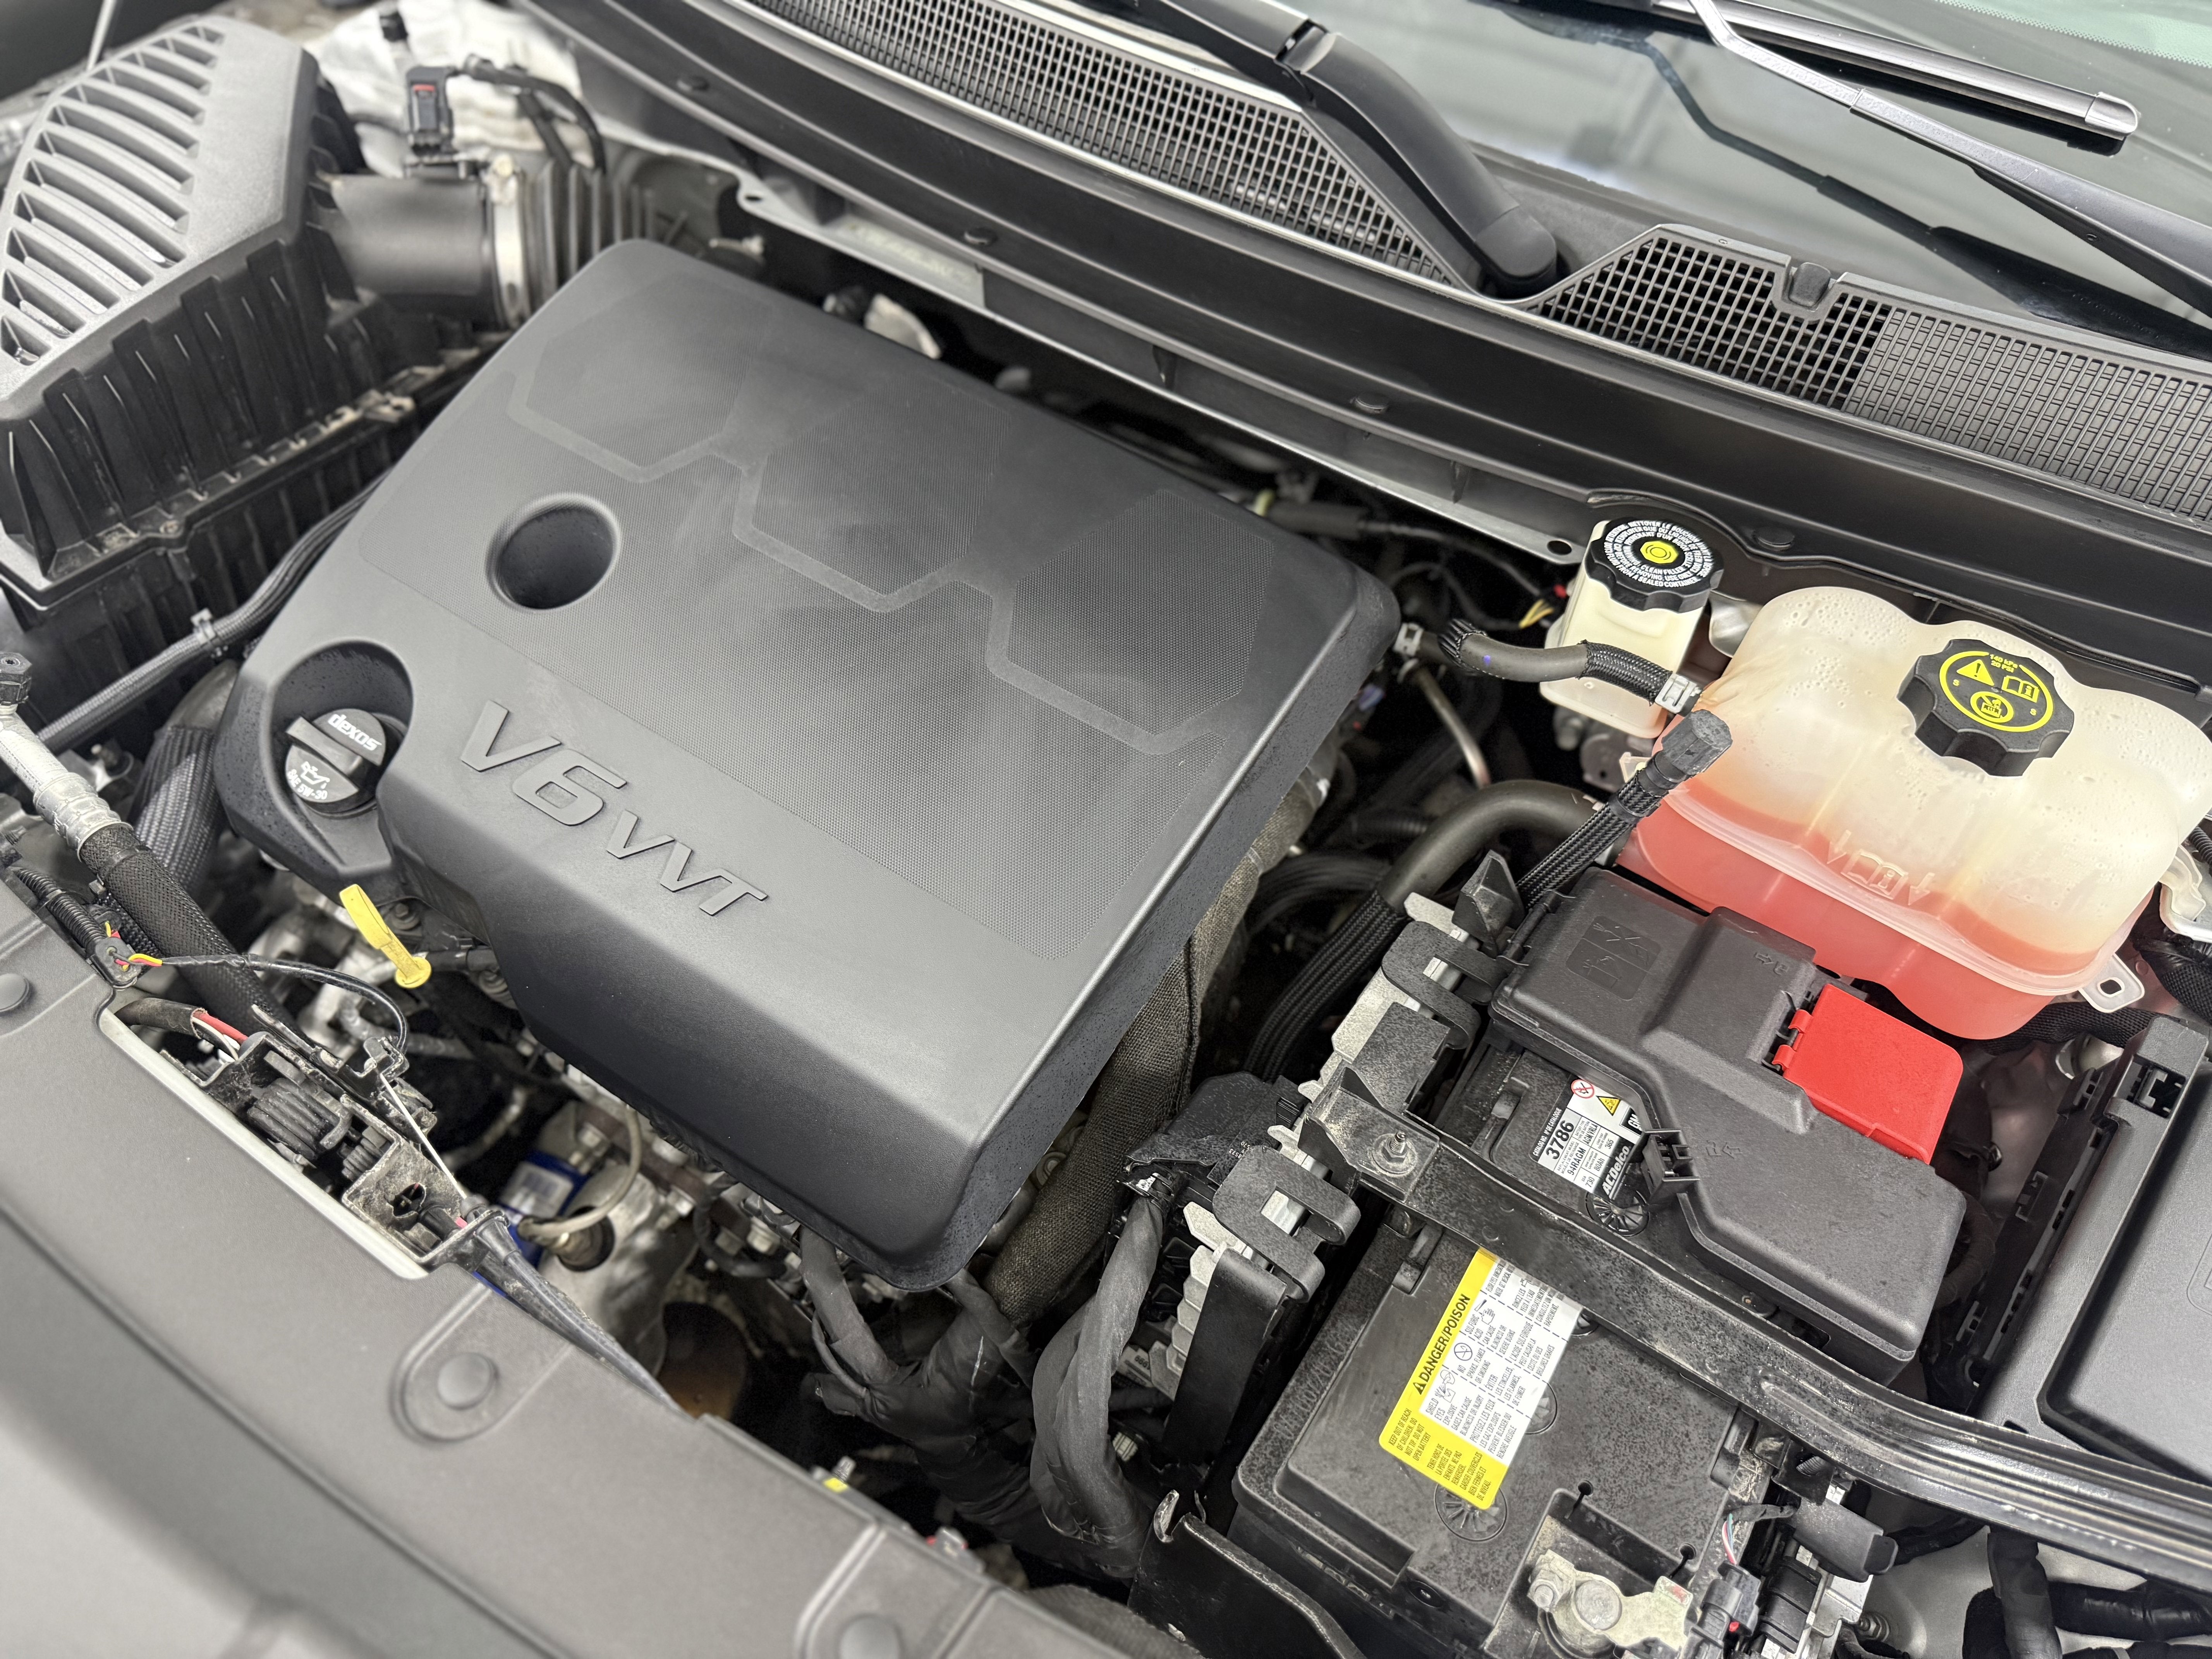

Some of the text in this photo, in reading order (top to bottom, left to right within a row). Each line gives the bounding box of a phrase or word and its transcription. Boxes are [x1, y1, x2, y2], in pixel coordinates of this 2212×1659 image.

[1657, 532, 1673, 540] D'UN
[1672, 538, 1690, 551] BIDON
[1668, 531, 1692, 544] LIQUIDE
[1671, 526, 1702, 542] BOUCHON
[1606, 553, 1621, 566] FLUID
[1616, 564, 1635, 577] FROM
[1638, 576, 1664, 587] SEALED
[1614, 551, 1633, 568] BEFORE
[1629, 566, 1664, 581] REMOVING.
[1677, 570, 1693, 580] ONLY
[1640, 564, 1662, 575] CLEAN
[1663, 566, 1686, 575] FILLER
[1990, 654, 2003, 663] 140
[2001, 664, 2014, 673] PSI
[328, 714, 382, 750] dexos
[297, 783, 328, 800] 5W-30
[460, 699, 768, 916] V6 VVT
[1548, 1107, 1561, 1126] CATALOGUE
[1628, 1114, 1640, 1129] GM
[1546, 1120, 1574, 1159] 3786
[1604, 1139, 1614, 1149] 365
[1532, 1140, 1544, 1156] CATALOG
[1567, 1147, 1586, 1175] 94RAGM
[1594, 1158, 1605, 1171] 80Ah
[1602, 1146, 1630, 1195] ACDelco
[1585, 1176, 1595, 1187] 730
[1518, 1288, 1526, 1296] LES
[1465, 1314, 1479, 1334] SULFURIC
[1419, 1294, 1469, 1381] DANGER/POISON
[1474, 1328, 1483, 1340] ACID
[1482, 1325, 1496, 1345] CAN CAUSE
[1509, 1321, 1533, 1361] L'ACIDE SULFURIQUE
[1499, 1329, 1515, 1355] SEVERE BURNS
[1474, 1348, 1486, 1363] FLAMES
[1535, 1346, 1543, 1355] DES
[1544, 1344, 1554, 1359] GRAVES
[1518, 1355, 1527, 1366] PEUT
[1457, 1365, 1466, 1373] NO
[1477, 1360, 1490, 1377] SMOKING
[1494, 1387, 1503, 1396] LES
[1503, 1391, 1511, 1401] LES
[1515, 1386, 1525, 1400] FUMER
[1425, 1398, 1438, 1415] SHIELD
[1484, 1398, 1496, 1412] YEUX
[1434, 1407, 1445, 1420] EYES
[1443, 1403, 1457, 1425] EXPLOSIVE
[1451, 1396, 1472, 1430] GASES CAN CAUSE
[1460, 1414, 1474, 1436] BLINDNESS
[1473, 1395, 1484, 1409] INJURY
[1480, 1410, 1490, 1421] LES
[1388, 1434, 1397, 1446] KEEP
[1393, 1426, 1402, 1436] OUT
[1400, 1408, 1412, 1422] REACH
[1415, 1423, 1424, 1434] NOT
[1479, 1412, 1501, 1448] LES GAZ EXPLOSIFS
[1412, 1432, 1420, 1440] DO
[1487, 1435, 1500, 1454] PEUVENT
[1496, 1419, 1508, 1437] BLESSER
[1496, 1425, 1516, 1459] RENDRE AVEUGLE
[1404, 1445, 1413, 1456] NOT
[1412, 1432, 1431, 1461] OPEN BATTERY
[1432, 1448, 1442, 1460] HORS
[1444, 1448, 1452, 1457] DES
[1453, 1450, 1462, 1459] PAS
[1459, 1451, 1482, 1490] GARDER COUVERCLES
[1468, 1486, 1477, 1496] BIEN
